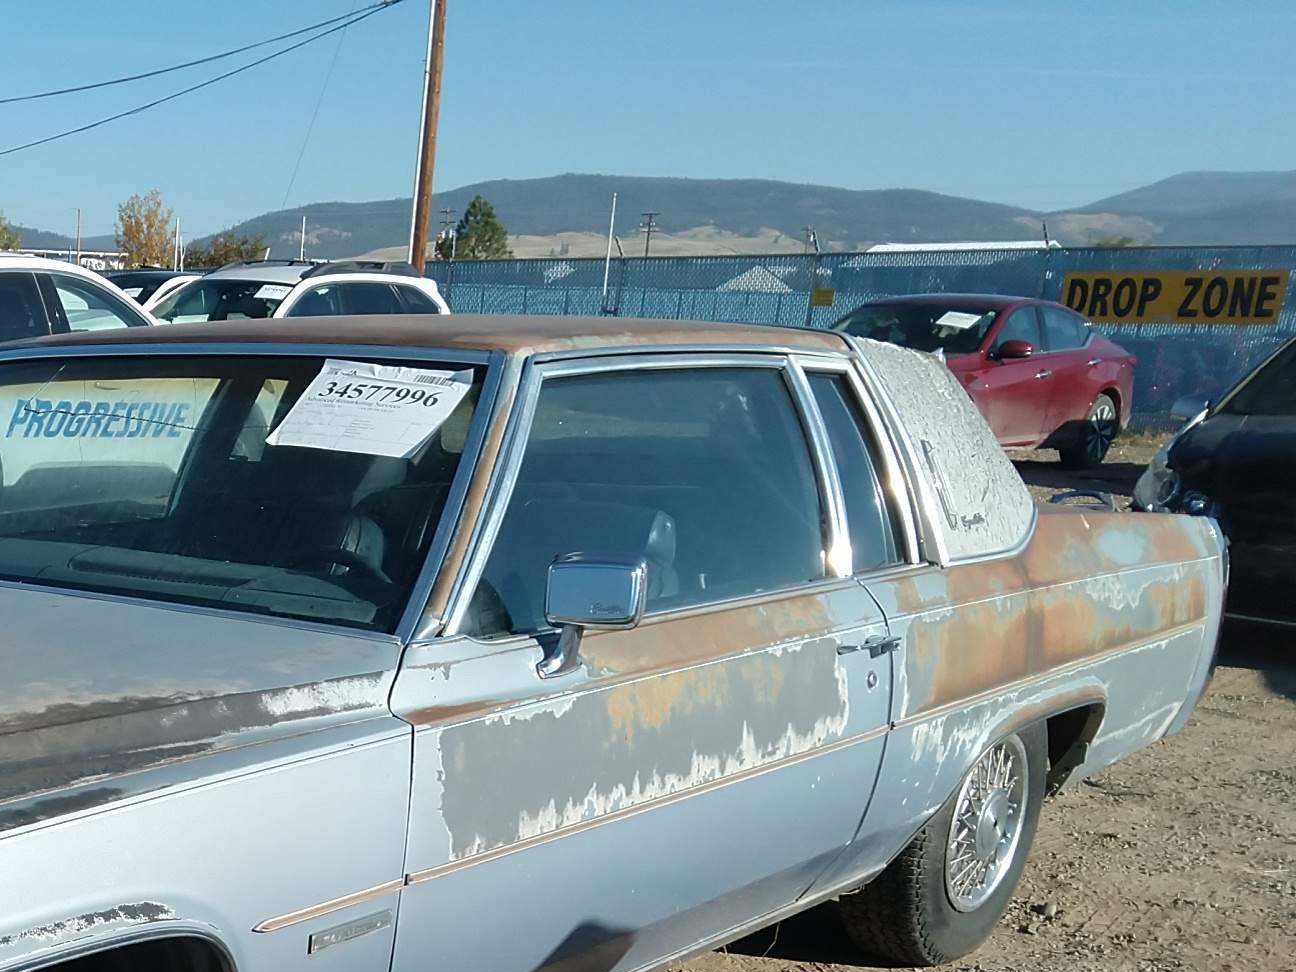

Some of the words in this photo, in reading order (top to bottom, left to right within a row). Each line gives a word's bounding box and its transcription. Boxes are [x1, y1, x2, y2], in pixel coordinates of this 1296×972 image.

[1066, 277, 1162, 318] DROP
[1177, 277, 1281, 318] ZONE
[318, 381, 444, 408] 34577996
[6, 399, 190, 438] PROGRESSIVE
